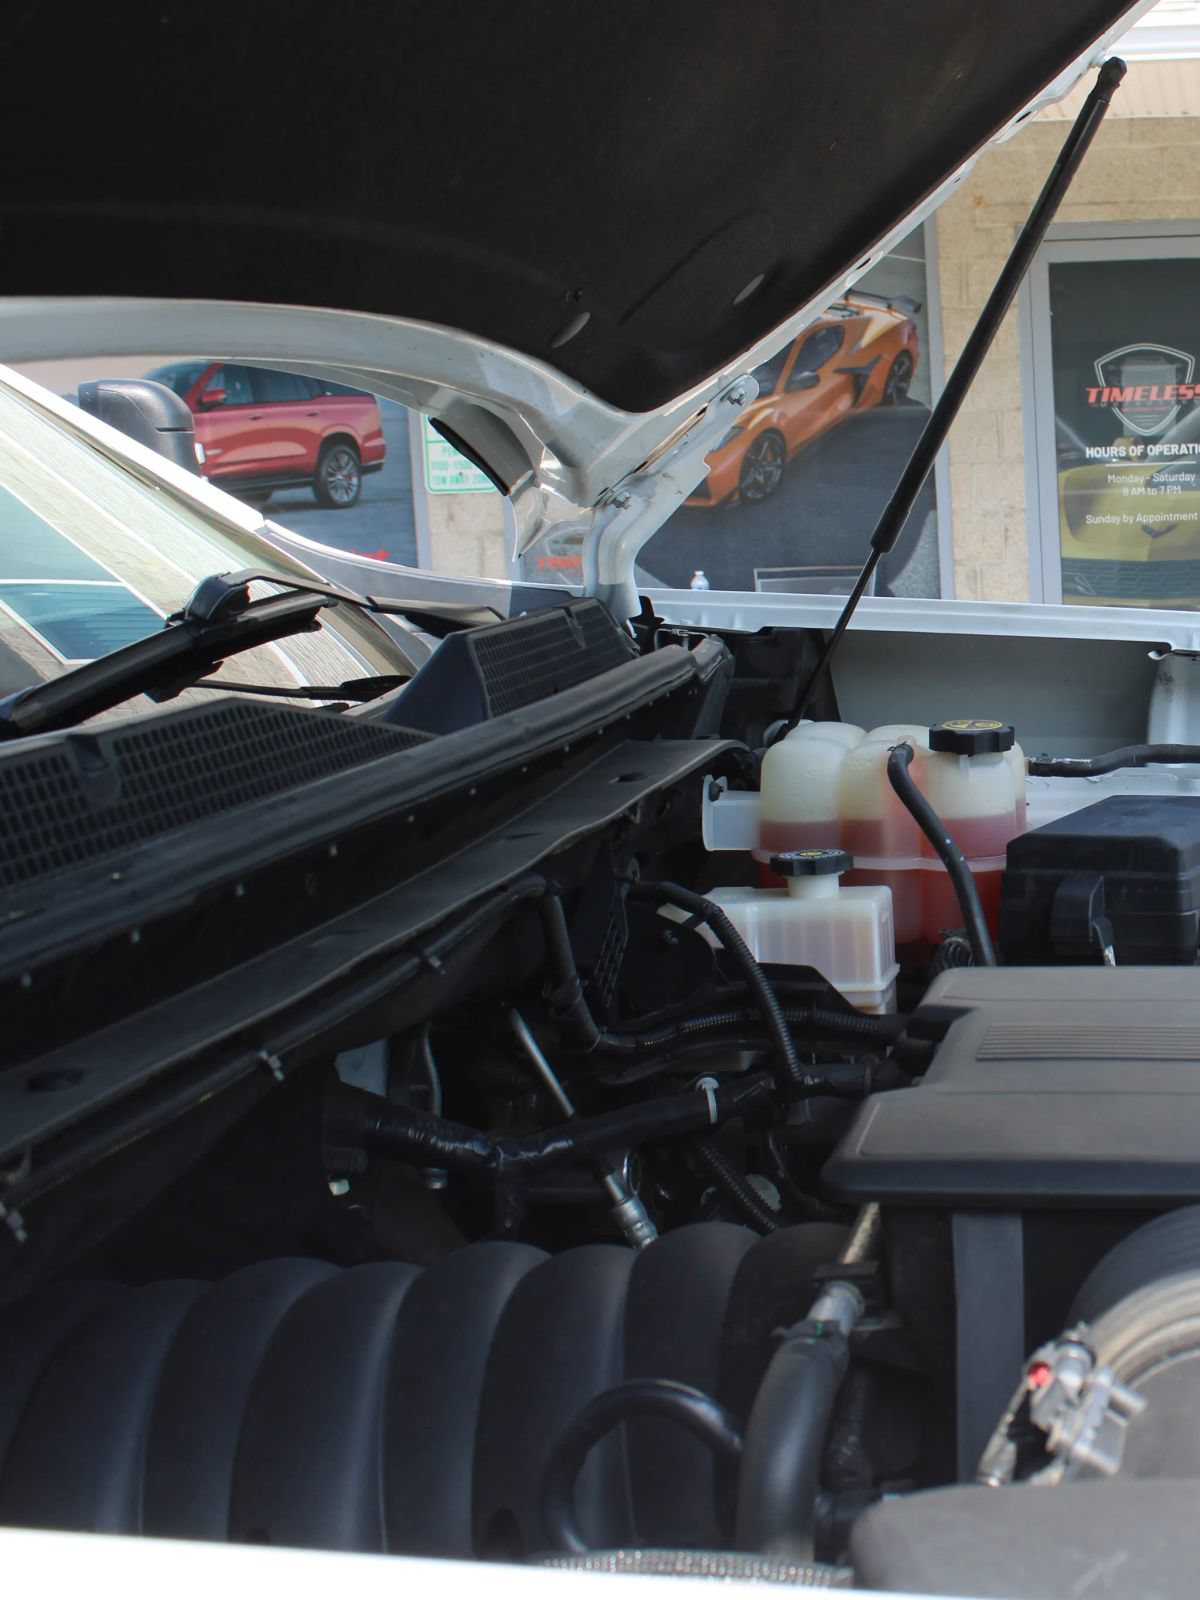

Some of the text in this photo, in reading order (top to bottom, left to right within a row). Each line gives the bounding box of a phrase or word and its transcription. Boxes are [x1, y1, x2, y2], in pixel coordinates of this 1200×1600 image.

[1085, 446, 1126, 458] HOURS
[1129, 445, 1145, 457] OF
[1107, 473, 1144, 485] Monday
[1152, 472, 1196, 483] Saturday
[1131, 487, 1145, 496] AM
[1147, 486, 1158, 495] to
[1158, 486, 1165, 495] 7
[1167, 485, 1181, 495] PM
[1085, 514, 1121, 525] Sunday
[1122, 514, 1134, 524] by
[1136, 511, 1198, 523] Appointment
